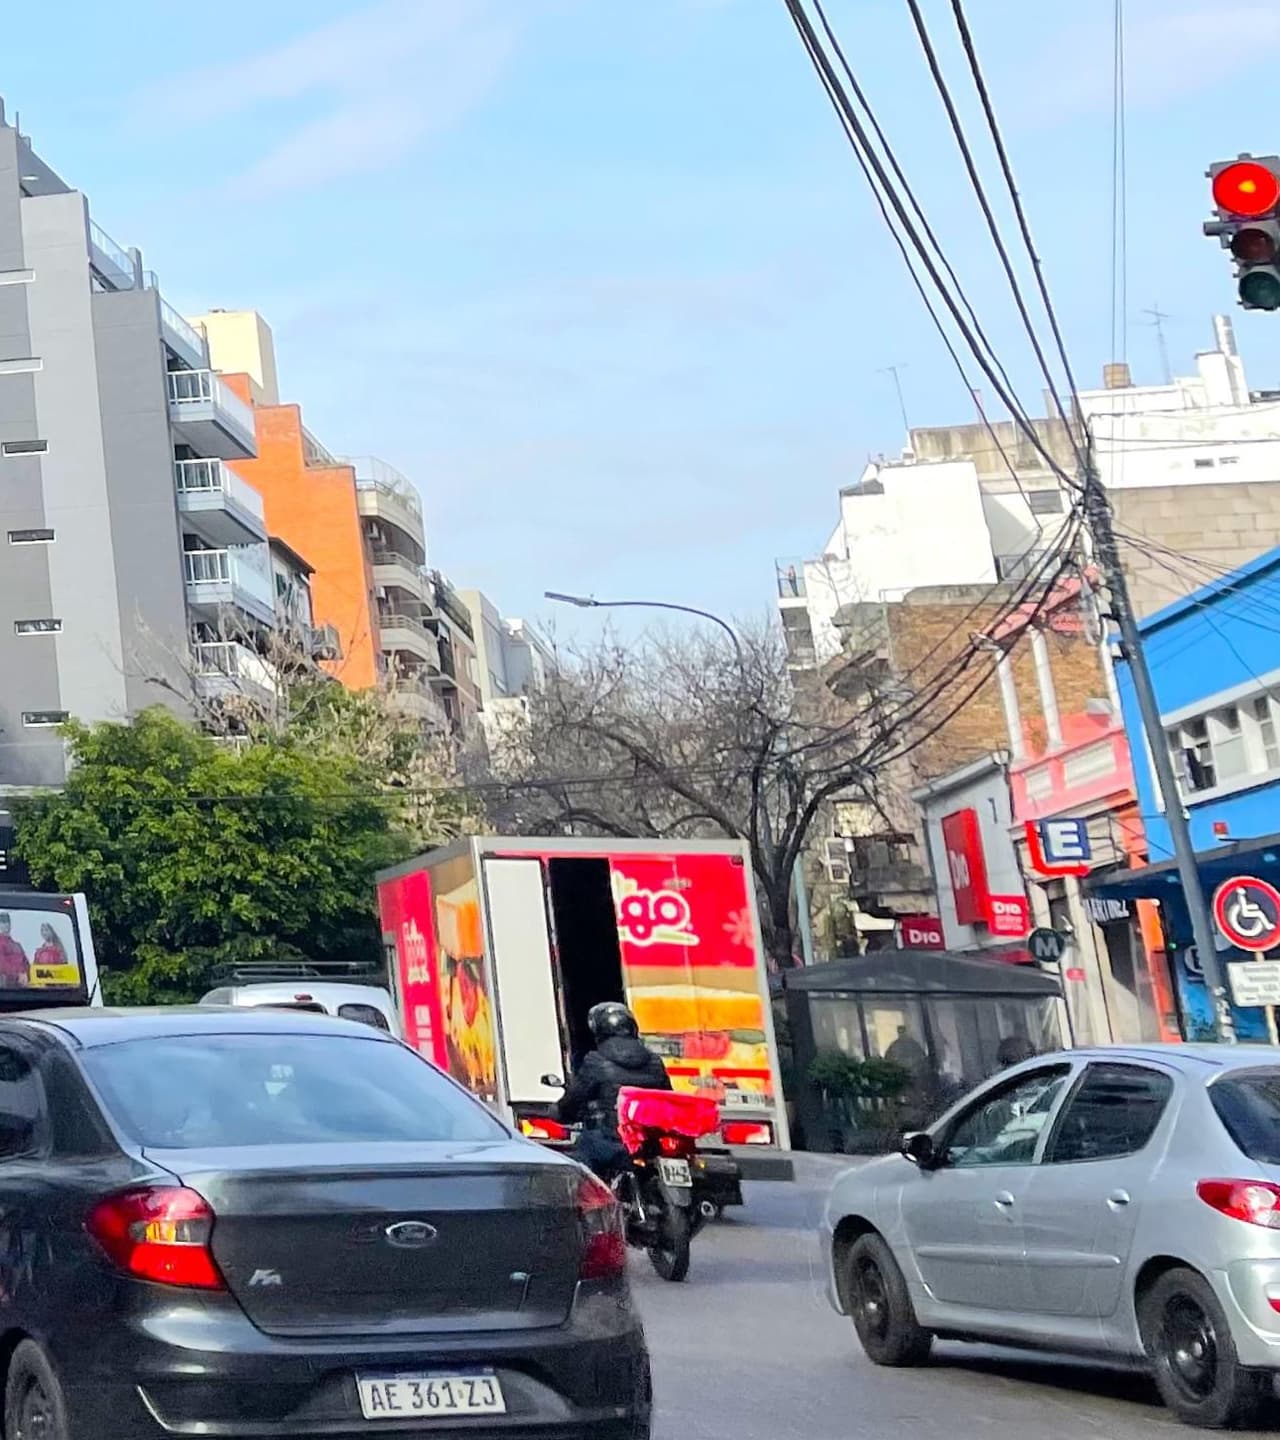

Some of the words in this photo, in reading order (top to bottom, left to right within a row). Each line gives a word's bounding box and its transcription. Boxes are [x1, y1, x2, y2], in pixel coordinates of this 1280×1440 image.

[371, 1383, 402, 1411] AE
[407, 1381, 458, 1410] 361
[462, 1379, 497, 1407] ZJ
